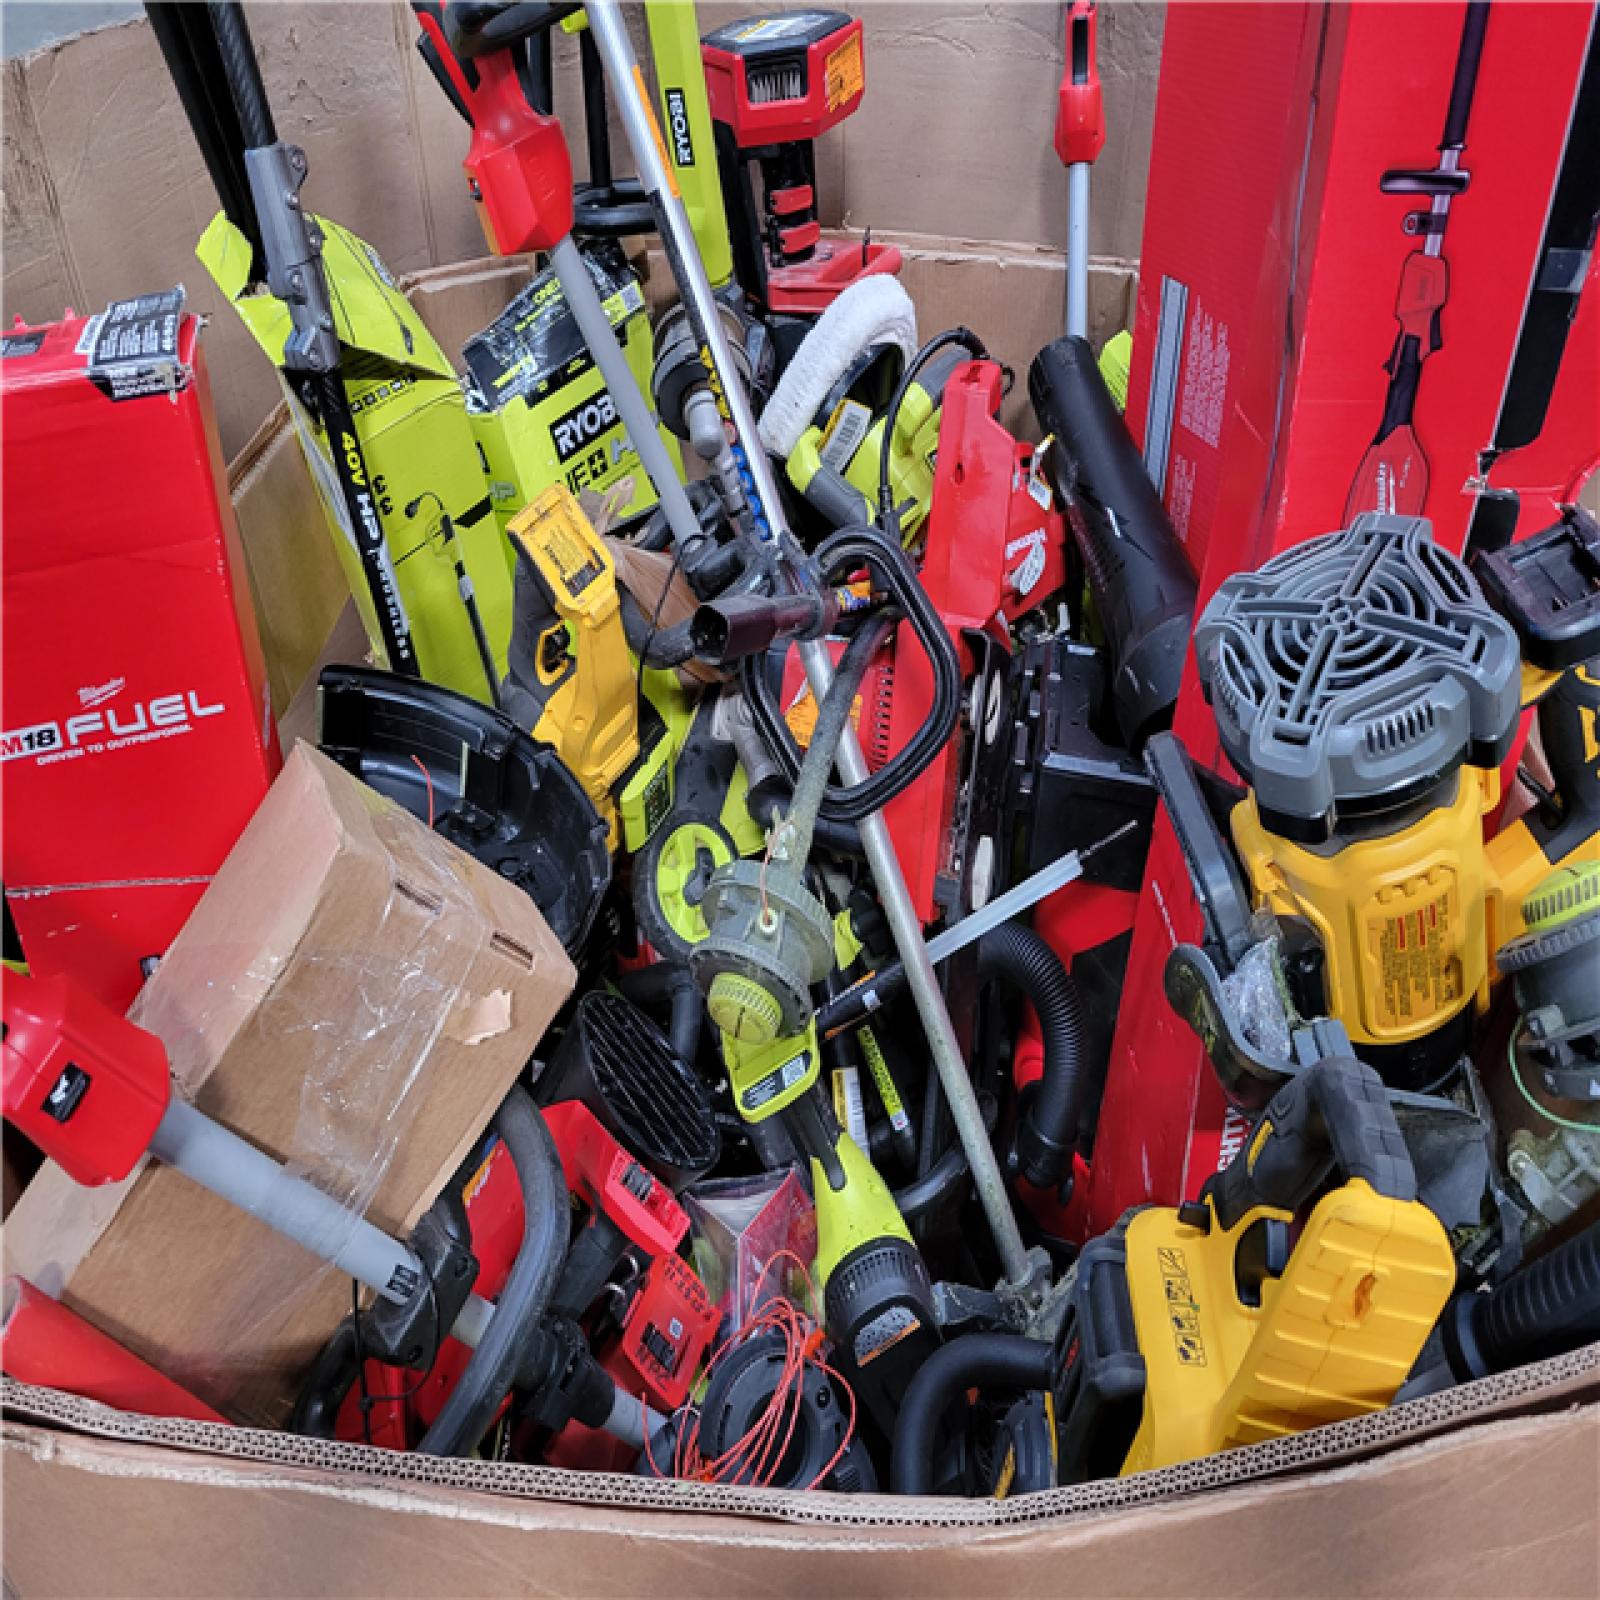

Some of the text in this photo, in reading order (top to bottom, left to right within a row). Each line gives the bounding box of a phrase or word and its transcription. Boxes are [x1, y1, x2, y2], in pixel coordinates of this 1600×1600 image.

[554, 394, 616, 456] RYOB
[342, 431, 379, 541] 40V HP
[2, 728, 56, 757] M18
[66, 690, 225, 746] FUEL
